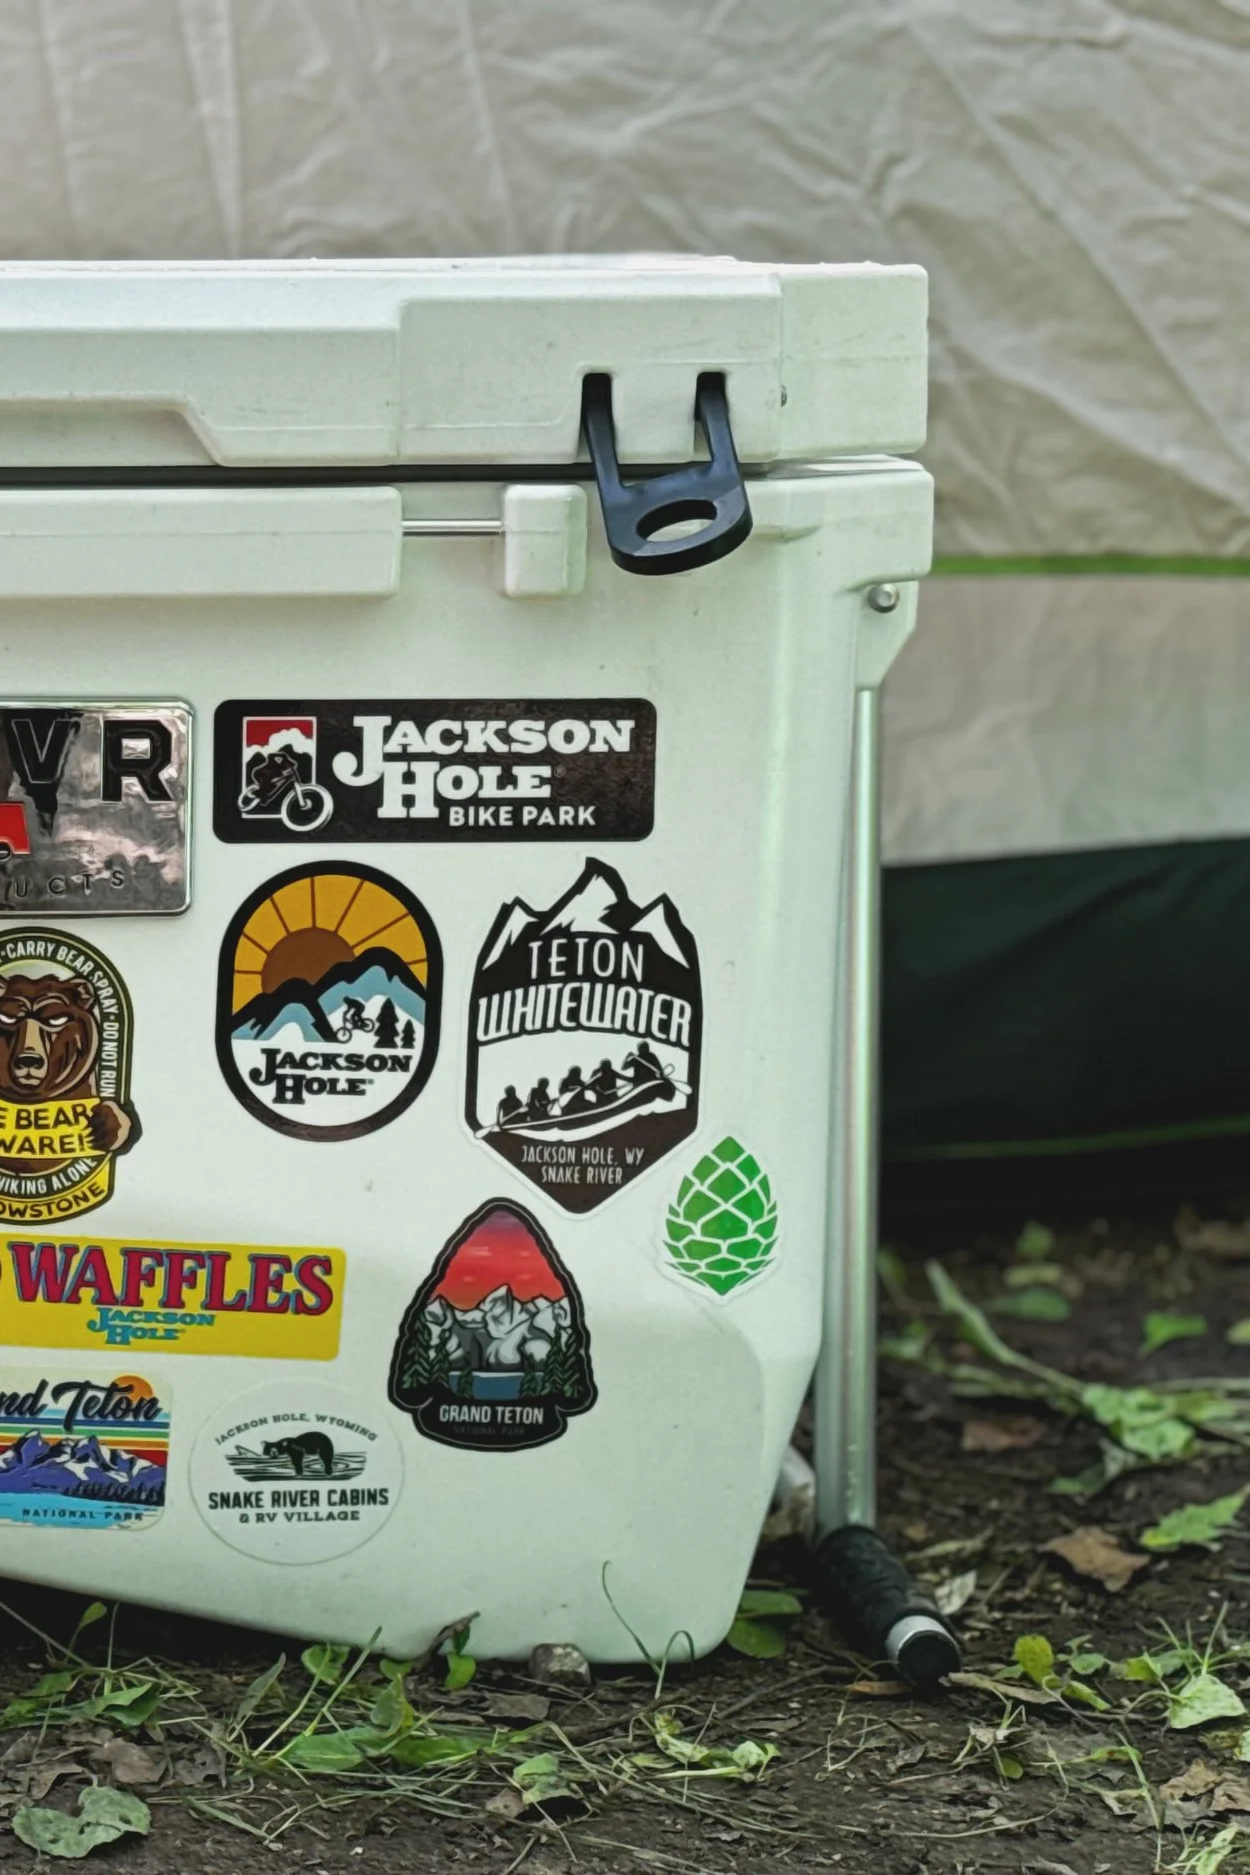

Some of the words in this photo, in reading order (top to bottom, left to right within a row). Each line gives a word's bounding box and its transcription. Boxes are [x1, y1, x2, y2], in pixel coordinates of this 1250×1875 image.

[332, 715, 635, 787] JACKSON
[449, 806, 514, 827] BIKE
[522, 806, 597, 827] PARK
[6, 940, 54, 960] CARRY
[57, 947, 94, 975] BEAR
[528, 937, 644, 983] TETON
[91, 971, 118, 1014] SPRAY
[475, 982, 693, 1048] WHITEWATER
[249, 1048, 414, 1087] JACKSON
[100, 1070, 118, 1098] RUN
[15, 1104, 90, 1131] BEAR
[520, 1145, 576, 1165] JACKSON
[581, 1147, 619, 1166] HOLE,
[625, 1147, 645, 1166] WY
[52, 1156, 97, 1190] ALONE
[541, 1166, 581, 1184] SNAKE
[586, 1167, 623, 1185] RIVER
[7, 1240, 334, 1316] WAFFLES
[86, 1306, 217, 1331] JACKSON
[51, 1379, 163, 1433] Teton
[439, 1404, 491, 1423] GRAND
[495, 1405, 544, 1424] TETON
[214, 1416, 269, 1446] JACKSON
[315, 1414, 379, 1442] WYOMING
[208, 1491, 264, 1510] SNAKE
[271, 1489, 320, 1509] RIVER
[327, 1488, 389, 1507] CABINS
[22, 1508, 95, 1520] NATIONAL
[104, 1511, 145, 1521] PARK
[255, 1512, 278, 1523] RV
[283, 1510, 361, 1523] VILLAGE
